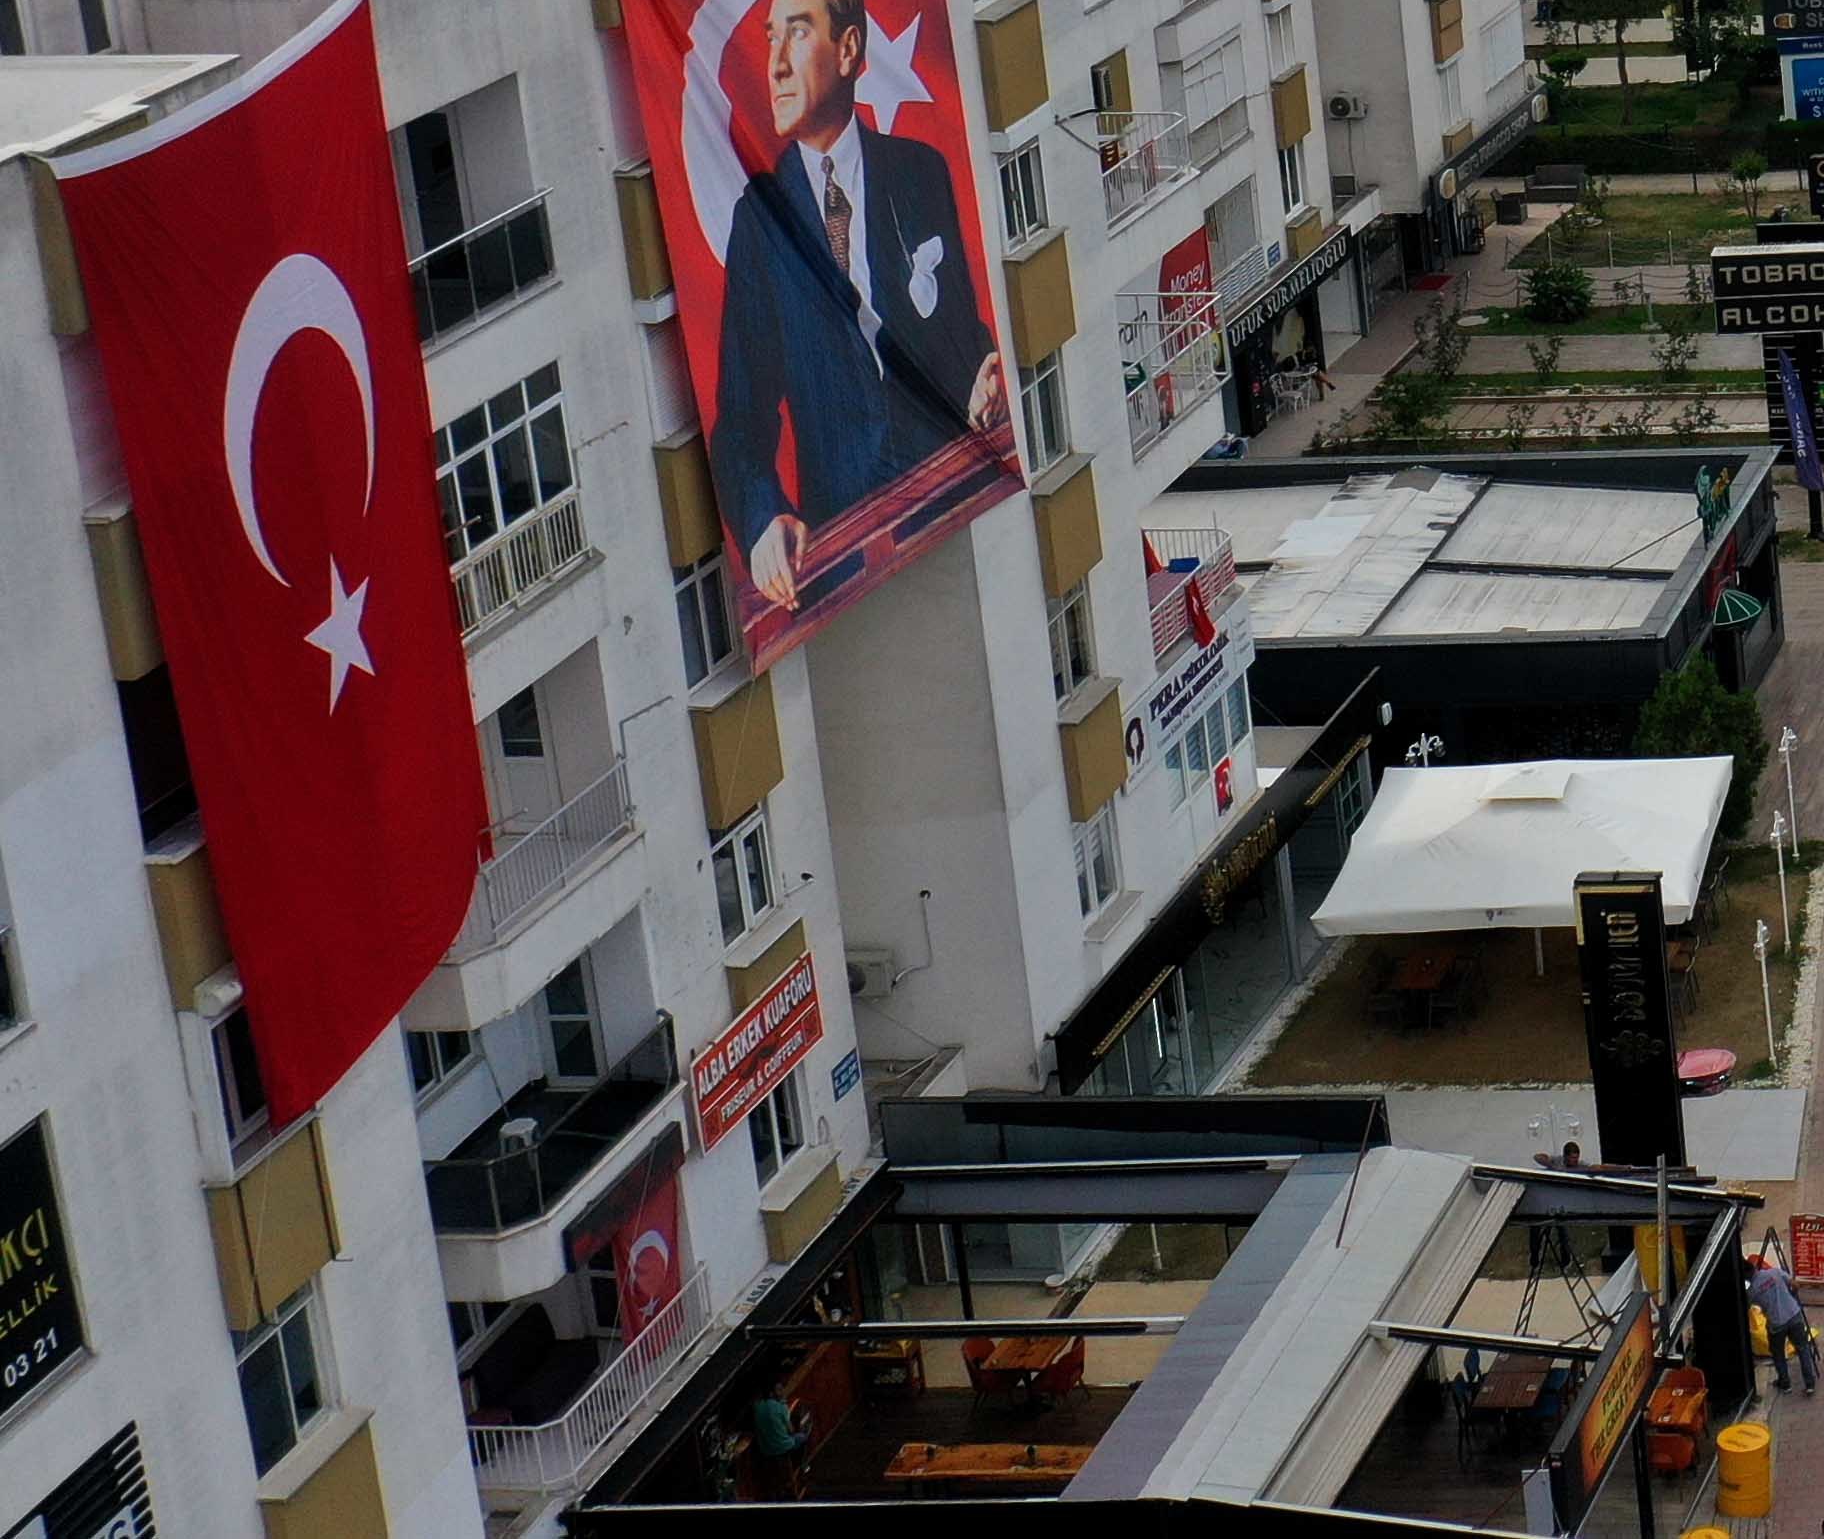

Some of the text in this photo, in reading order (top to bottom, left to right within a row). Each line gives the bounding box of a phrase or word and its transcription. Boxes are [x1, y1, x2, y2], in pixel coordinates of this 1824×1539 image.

[1170, 260, 1206, 297] Money
[698, 1051, 729, 1101] ALBA
[727, 1015, 766, 1071] ERKEK
[5, 1327, 59, 1388] 03 21
